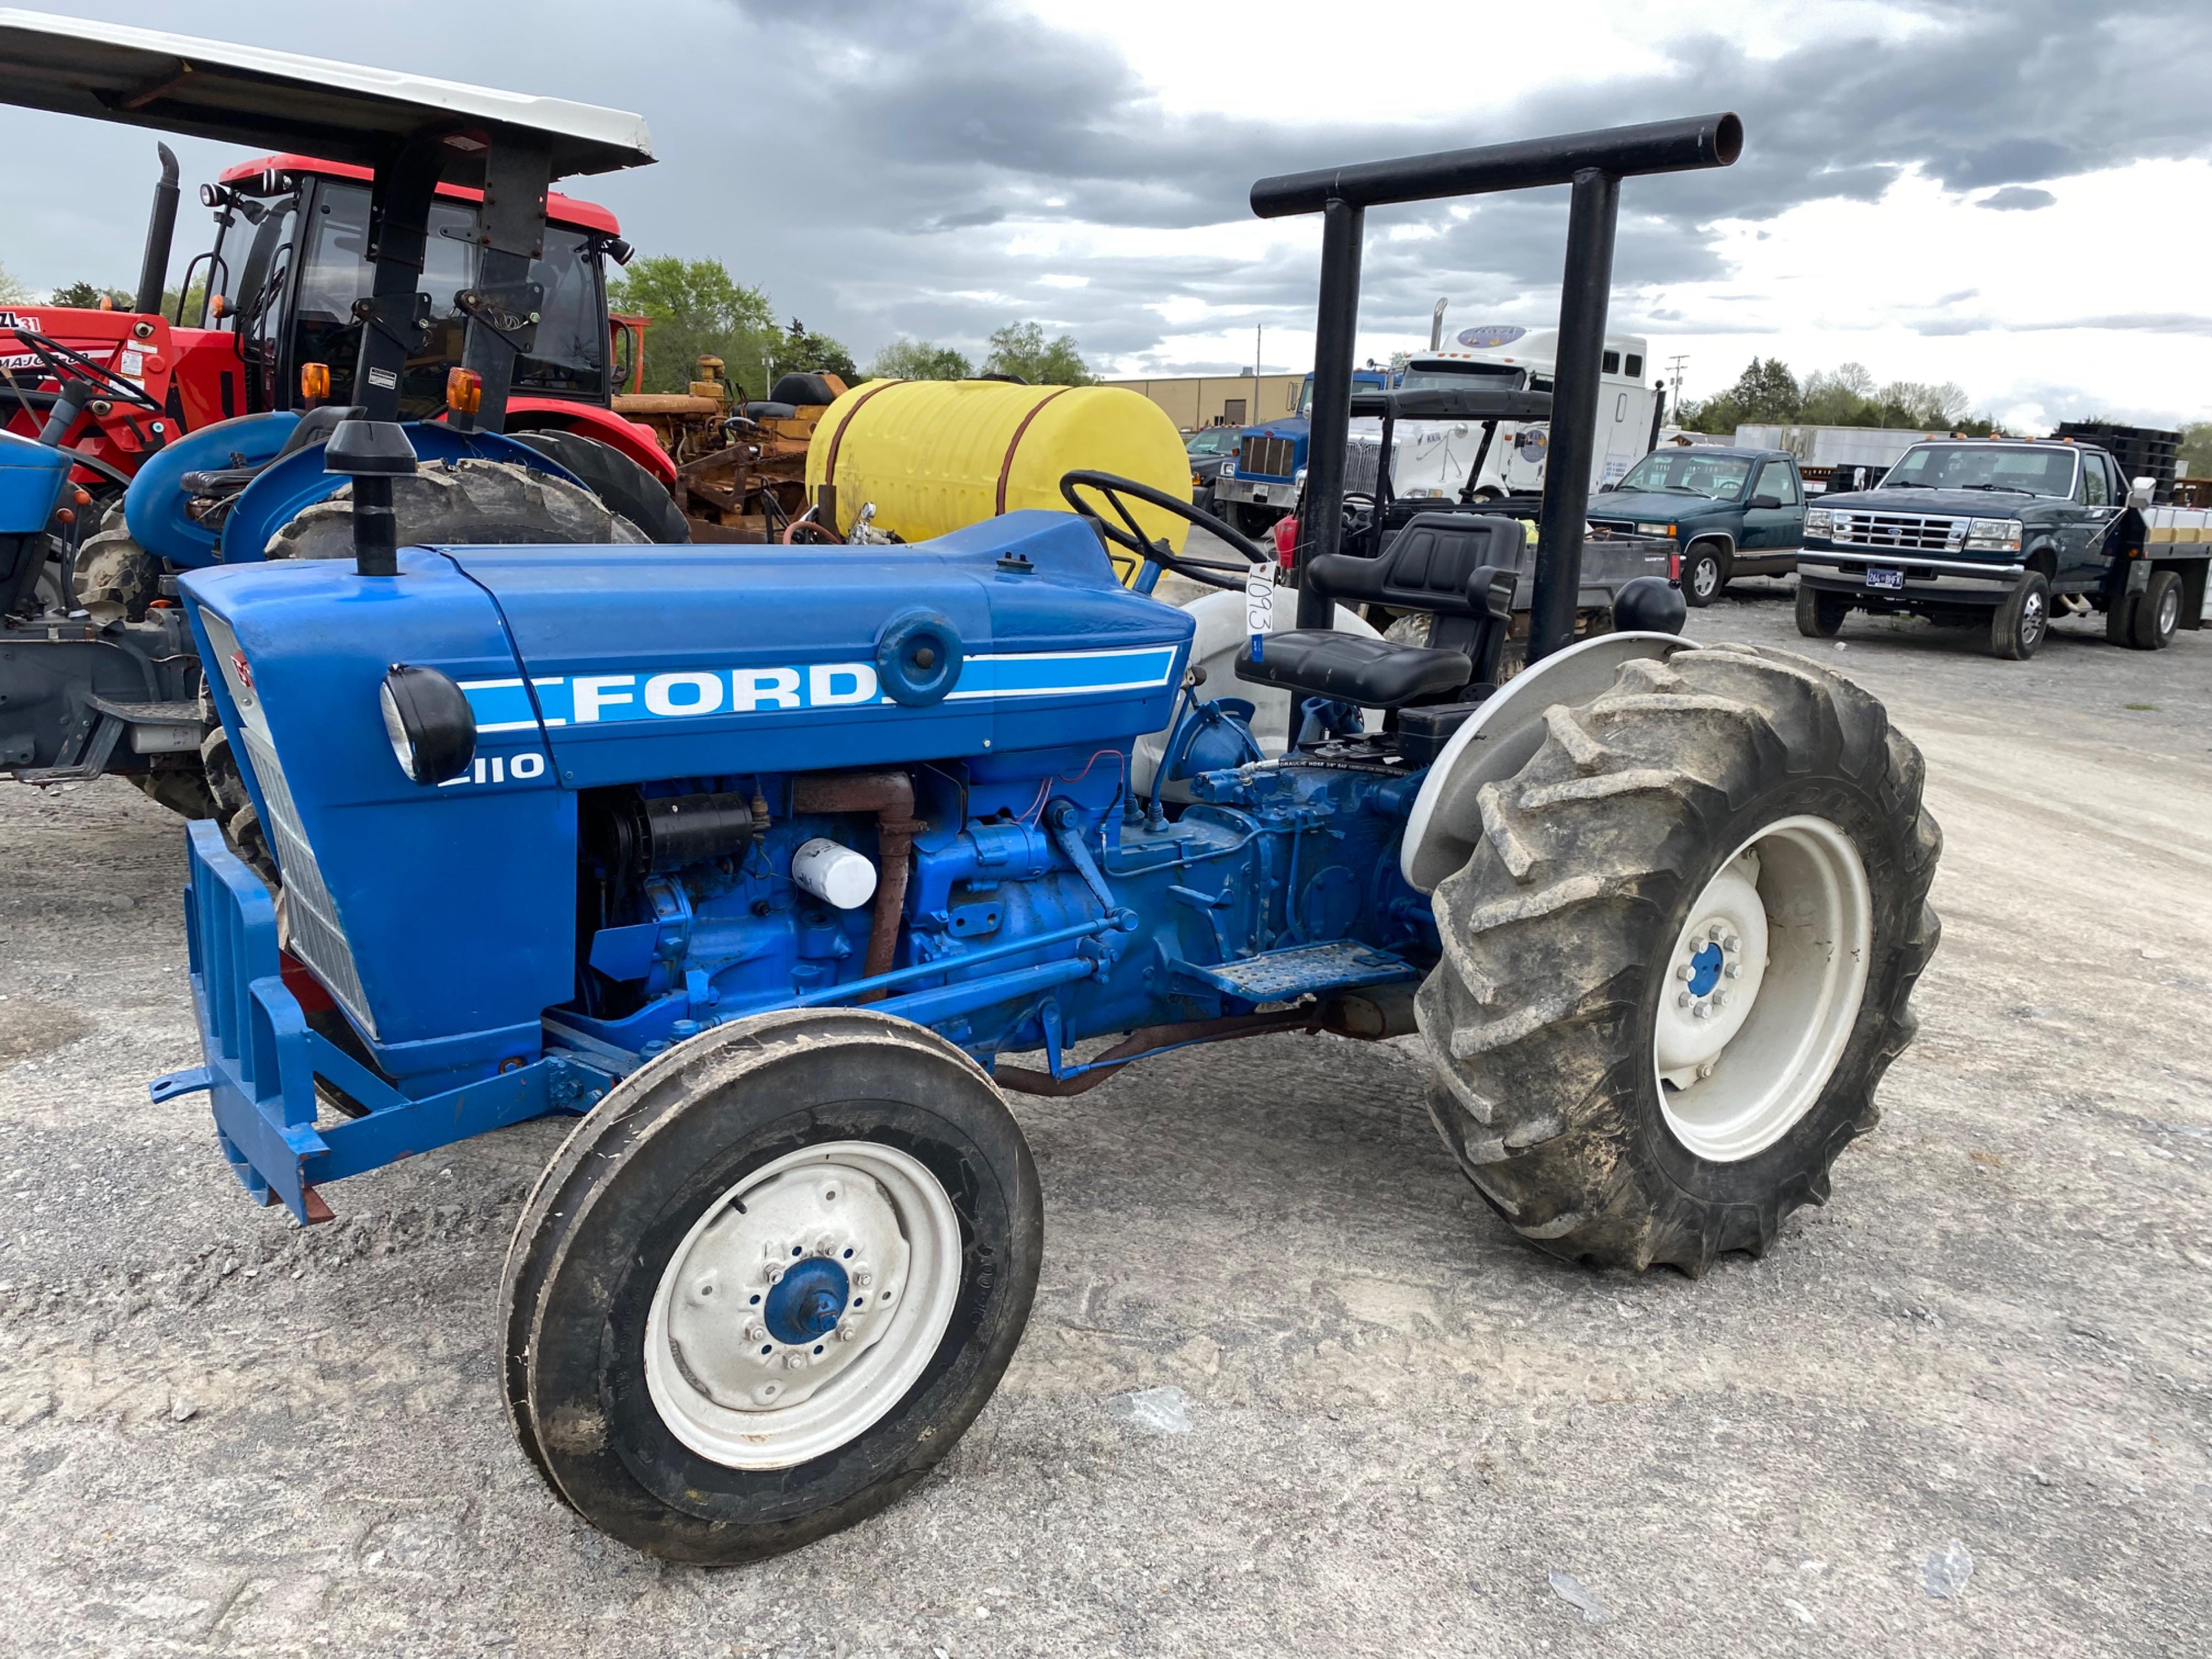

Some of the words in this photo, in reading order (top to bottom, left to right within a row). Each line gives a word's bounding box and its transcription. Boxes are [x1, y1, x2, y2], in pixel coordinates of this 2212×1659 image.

[21, 318, 39, 330] 31
[1248, 572, 1272, 630] 1093
[573, 663, 877, 722] FORD
[437, 753, 545, 787] 110
